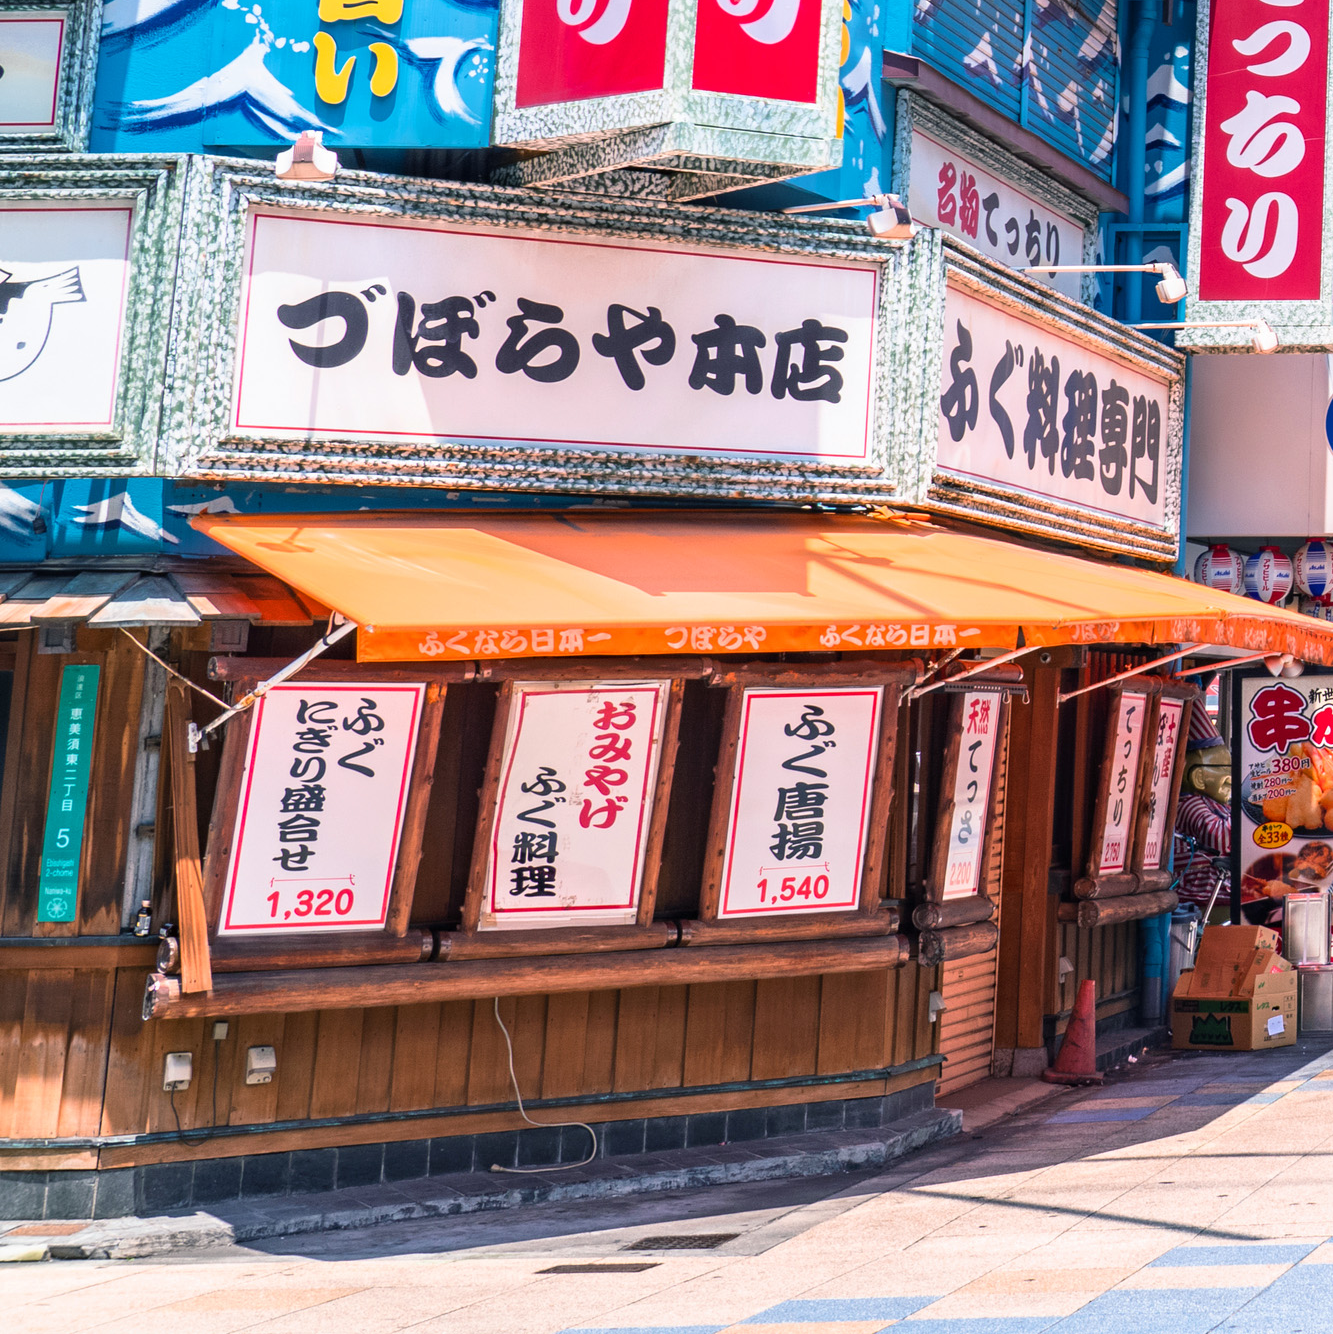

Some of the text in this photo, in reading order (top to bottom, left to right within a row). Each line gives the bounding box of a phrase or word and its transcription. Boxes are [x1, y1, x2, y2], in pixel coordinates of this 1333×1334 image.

[276, 283, 850, 404] づぼらや本店
[940, 317, 1162, 506] ふぐ料理専門
[60, 707, 84, 812] 恵美須東二丁目
[272, 697, 339, 873] にぎり盛合せ
[337, 697, 386, 778] ふぐ
[578, 700, 637, 830] おみやげ
[769, 704, 836, 863] ふぐ唐揚
[957, 739, 983, 845] てっさ
[1112, 705, 1137, 827] てっちり
[1271, 757, 1311, 775] 380円
[56, 828, 71, 849] 5
[508, 766, 568, 899] ふぐ料理
[756, 874, 831, 903] 1,540
[266, 888, 356, 919] 1,320
